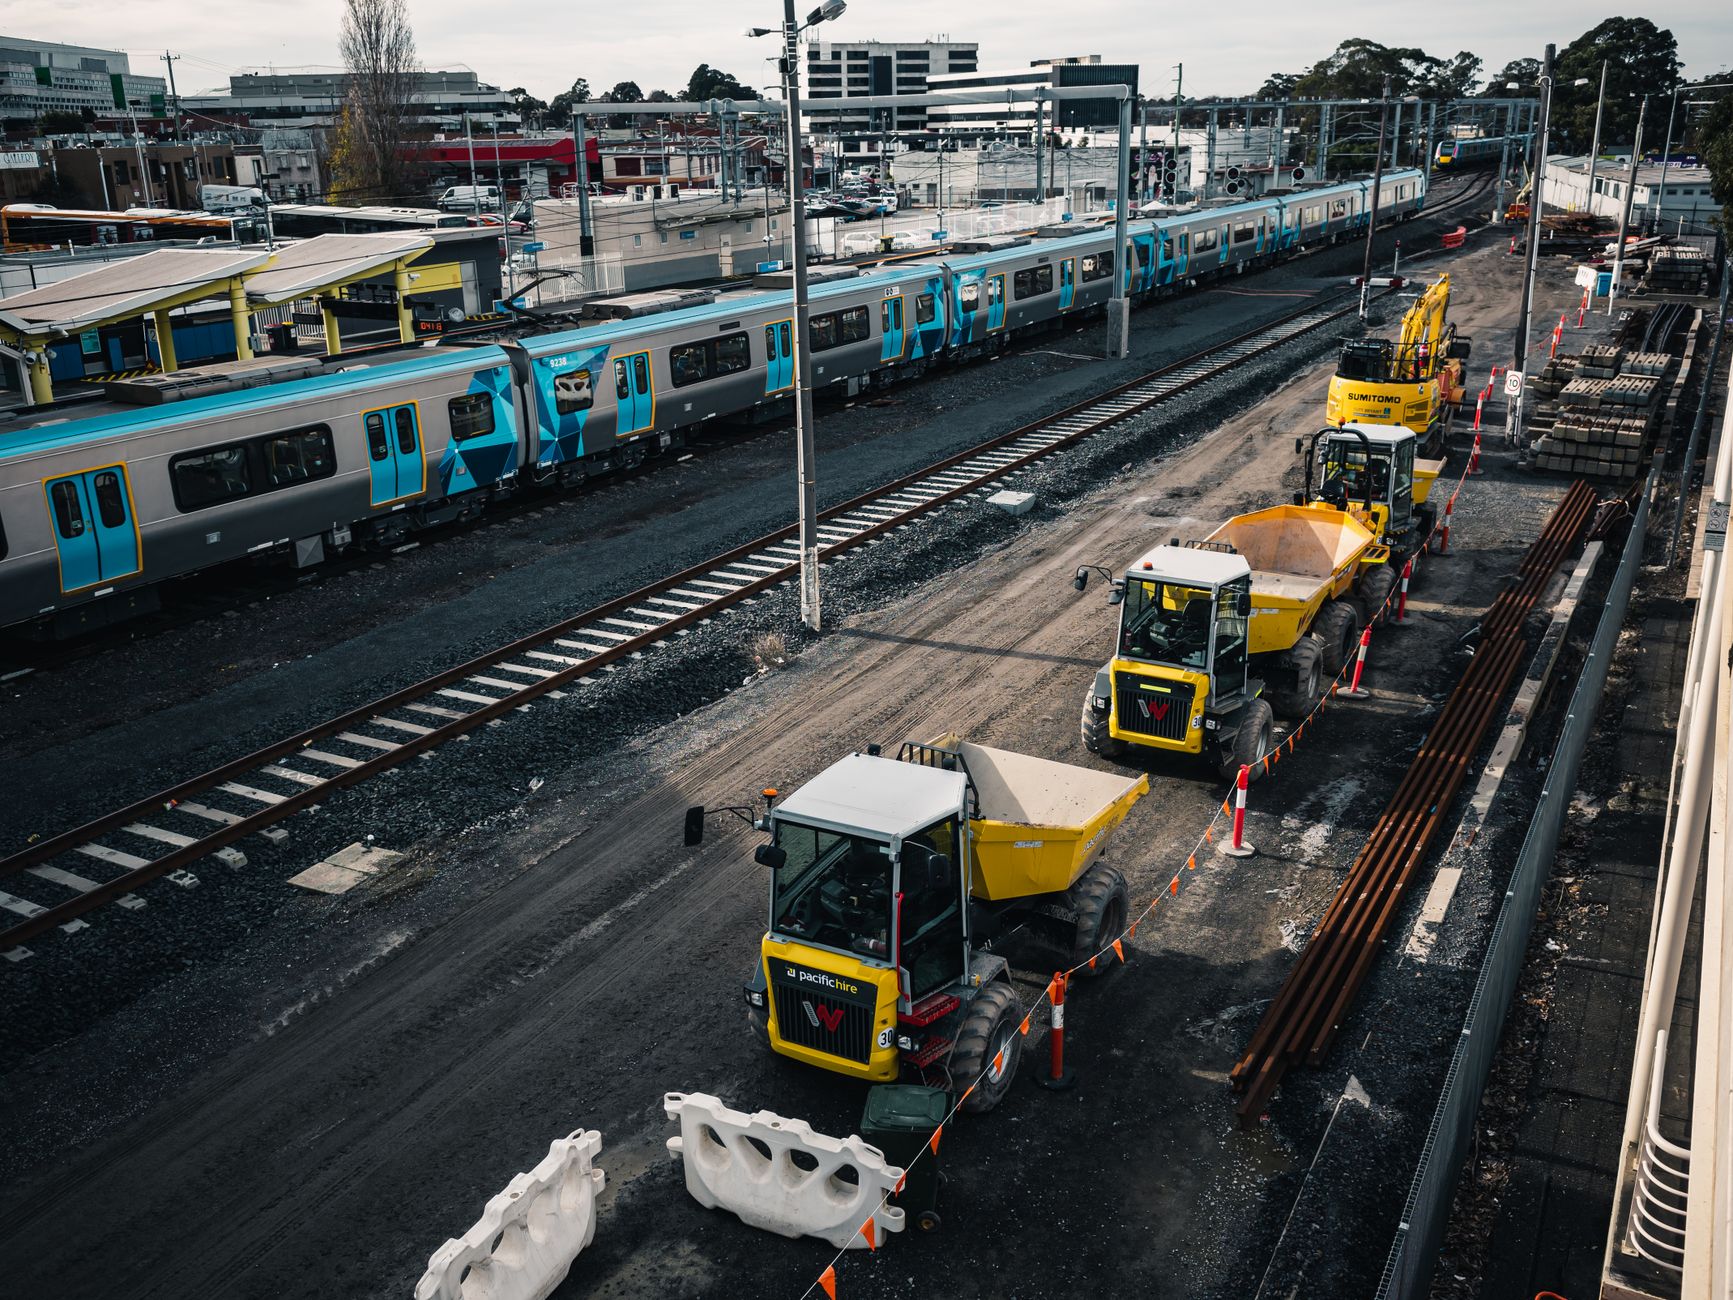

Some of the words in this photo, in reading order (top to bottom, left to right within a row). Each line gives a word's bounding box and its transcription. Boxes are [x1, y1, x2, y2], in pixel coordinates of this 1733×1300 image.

[1509, 379, 1519, 388] 10
[1347, 392, 1401, 405] SUMITOMO
[880, 1029, 893, 1046] 30
